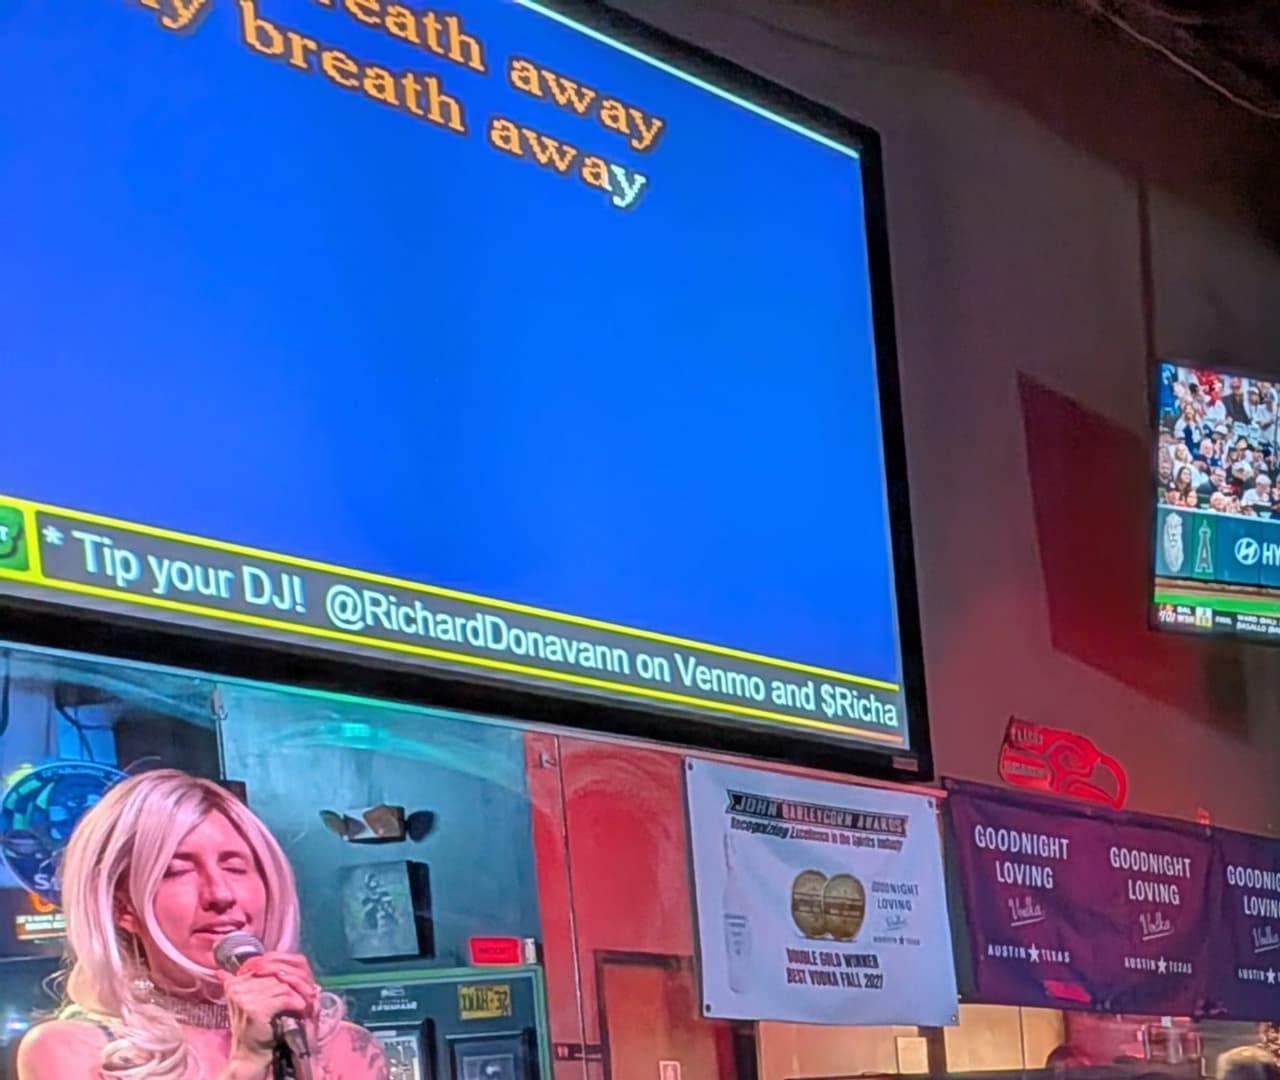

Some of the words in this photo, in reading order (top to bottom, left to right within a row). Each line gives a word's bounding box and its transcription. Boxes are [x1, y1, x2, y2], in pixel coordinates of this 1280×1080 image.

[317, 0, 486, 73] eath
[509, 56, 664, 151] away
[240, 0, 466, 133] breath
[490, 115, 648, 208] away
[72, 529, 143, 588] Tip
[147, 552, 235, 599] your
[242, 564, 308, 614] DJ!
[325, 584, 631, 676] @RichardDonavann
[636, 652, 672, 684] on
[673, 653, 766, 702] Venmo
[771, 679, 816, 712] and
[821, 683, 899, 728] $Richa
[975, 824, 1070, 861] GOODNIGHT
[996, 861, 1054, 890] LOVING
[1110, 846, 1191, 880] GOODNIGHT
[877, 898, 912, 912] LOVING
[1128, 878, 1180, 906] LOVING
[988, 943, 1027, 959] AUSTIN
[1040, 947, 1070, 964] TEXAS
[1124, 956, 1156, 972] AUSTIN
[1169, 959, 1193, 975] TEXAS
[1238, 968, 1265, 981] AUSTIN
